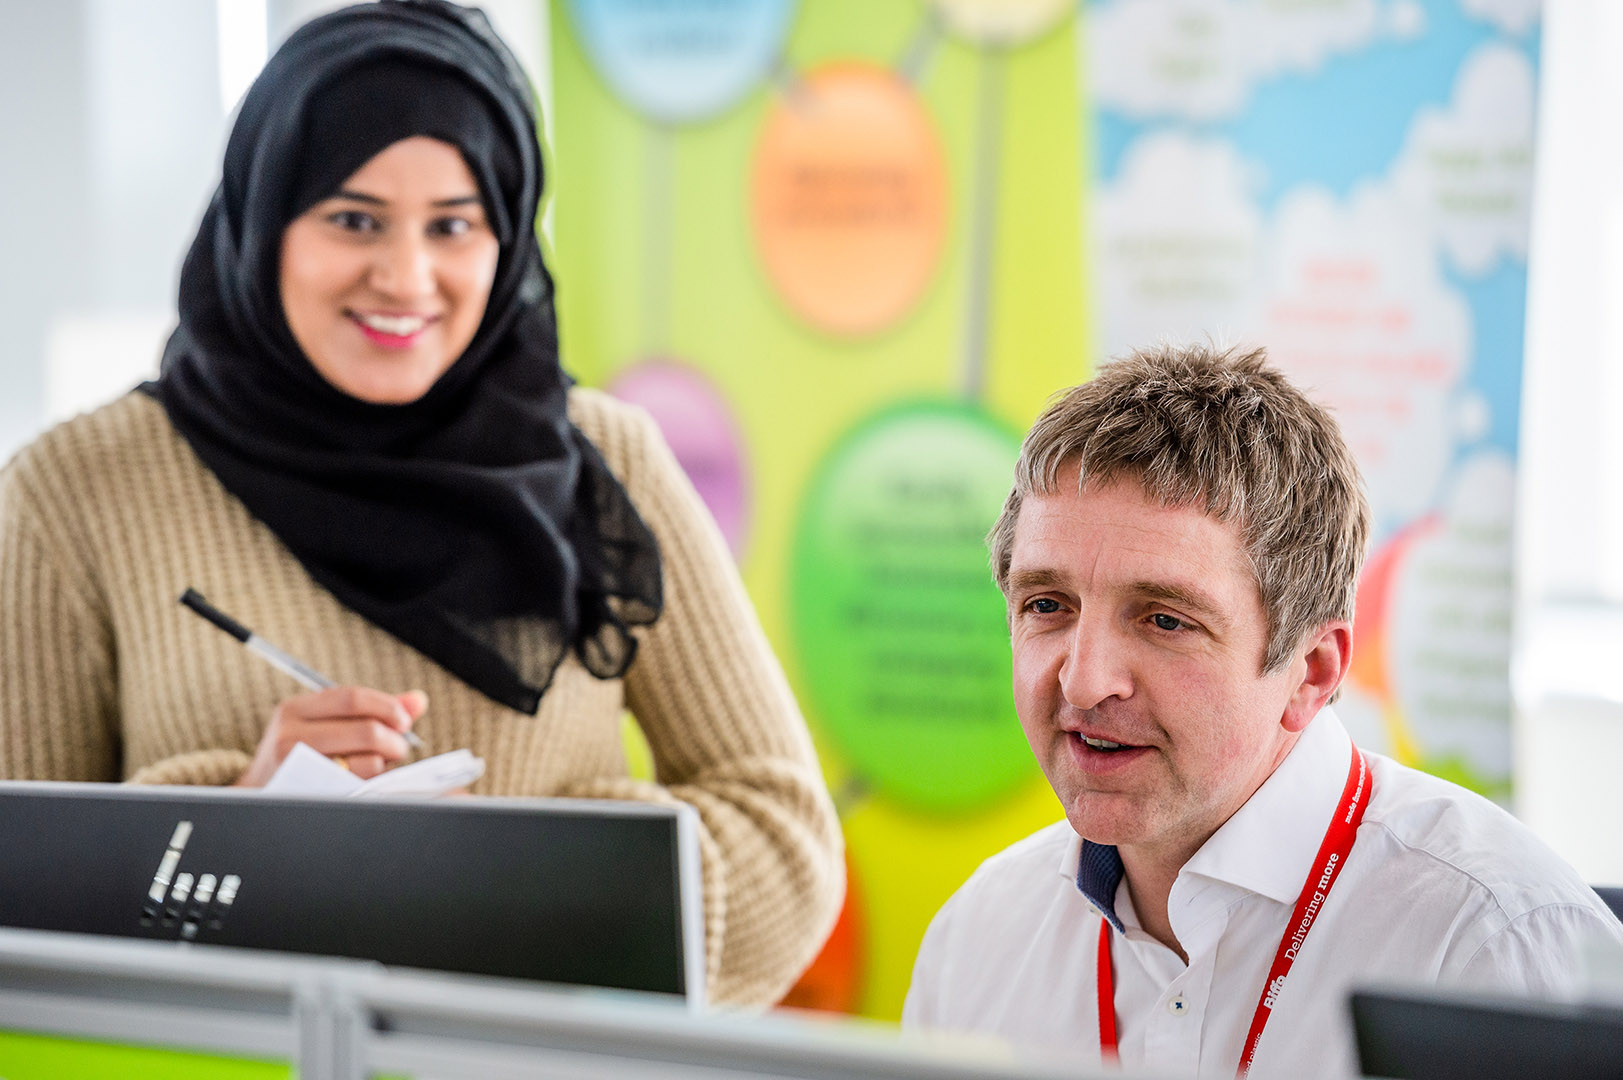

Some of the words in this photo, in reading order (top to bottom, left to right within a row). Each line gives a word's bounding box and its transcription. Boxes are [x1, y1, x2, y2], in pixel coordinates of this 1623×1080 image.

[1345, 802, 1357, 824] made
[1352, 786, 1362, 803] from
[1284, 890, 1325, 962] Delivering
[1318, 852, 1340, 890] more
